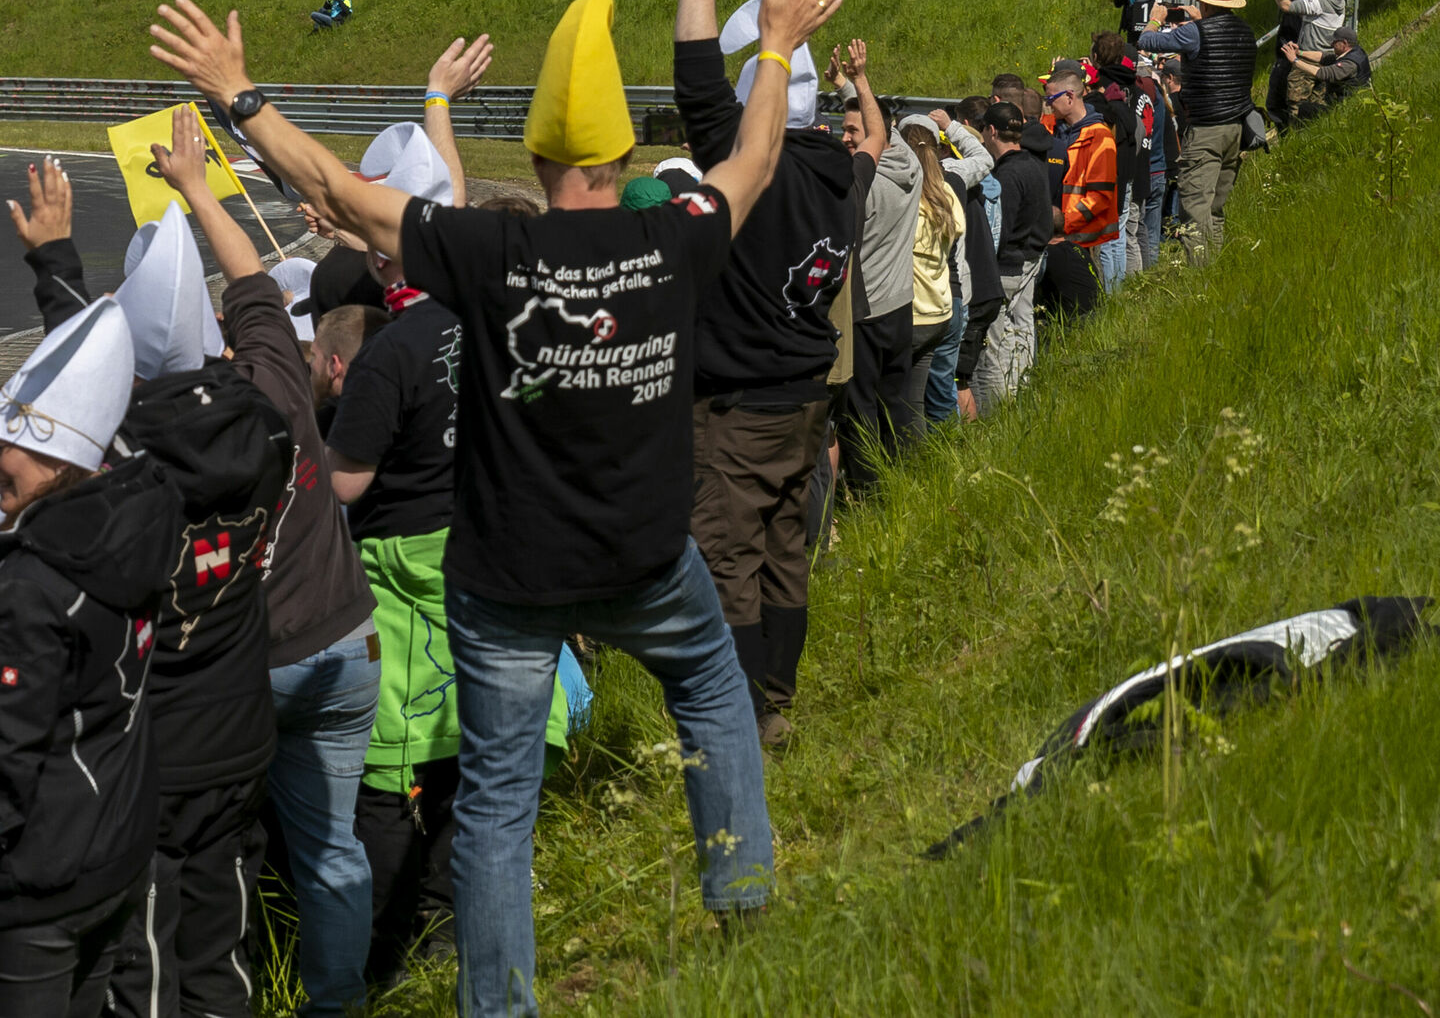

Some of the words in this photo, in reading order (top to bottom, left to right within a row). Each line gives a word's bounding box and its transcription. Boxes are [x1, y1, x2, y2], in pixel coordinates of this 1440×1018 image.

[555, 266, 582, 281] das
[586, 261, 615, 282] Kind
[619, 249, 663, 272] erstal
[507, 271, 528, 288] ins
[602, 272, 652, 298] gefalle
[537, 332, 676, 367] nürburgring
[558, 367, 602, 390] 24h
[606, 357, 676, 387] Rennen
[632, 375, 673, 405] 2018
